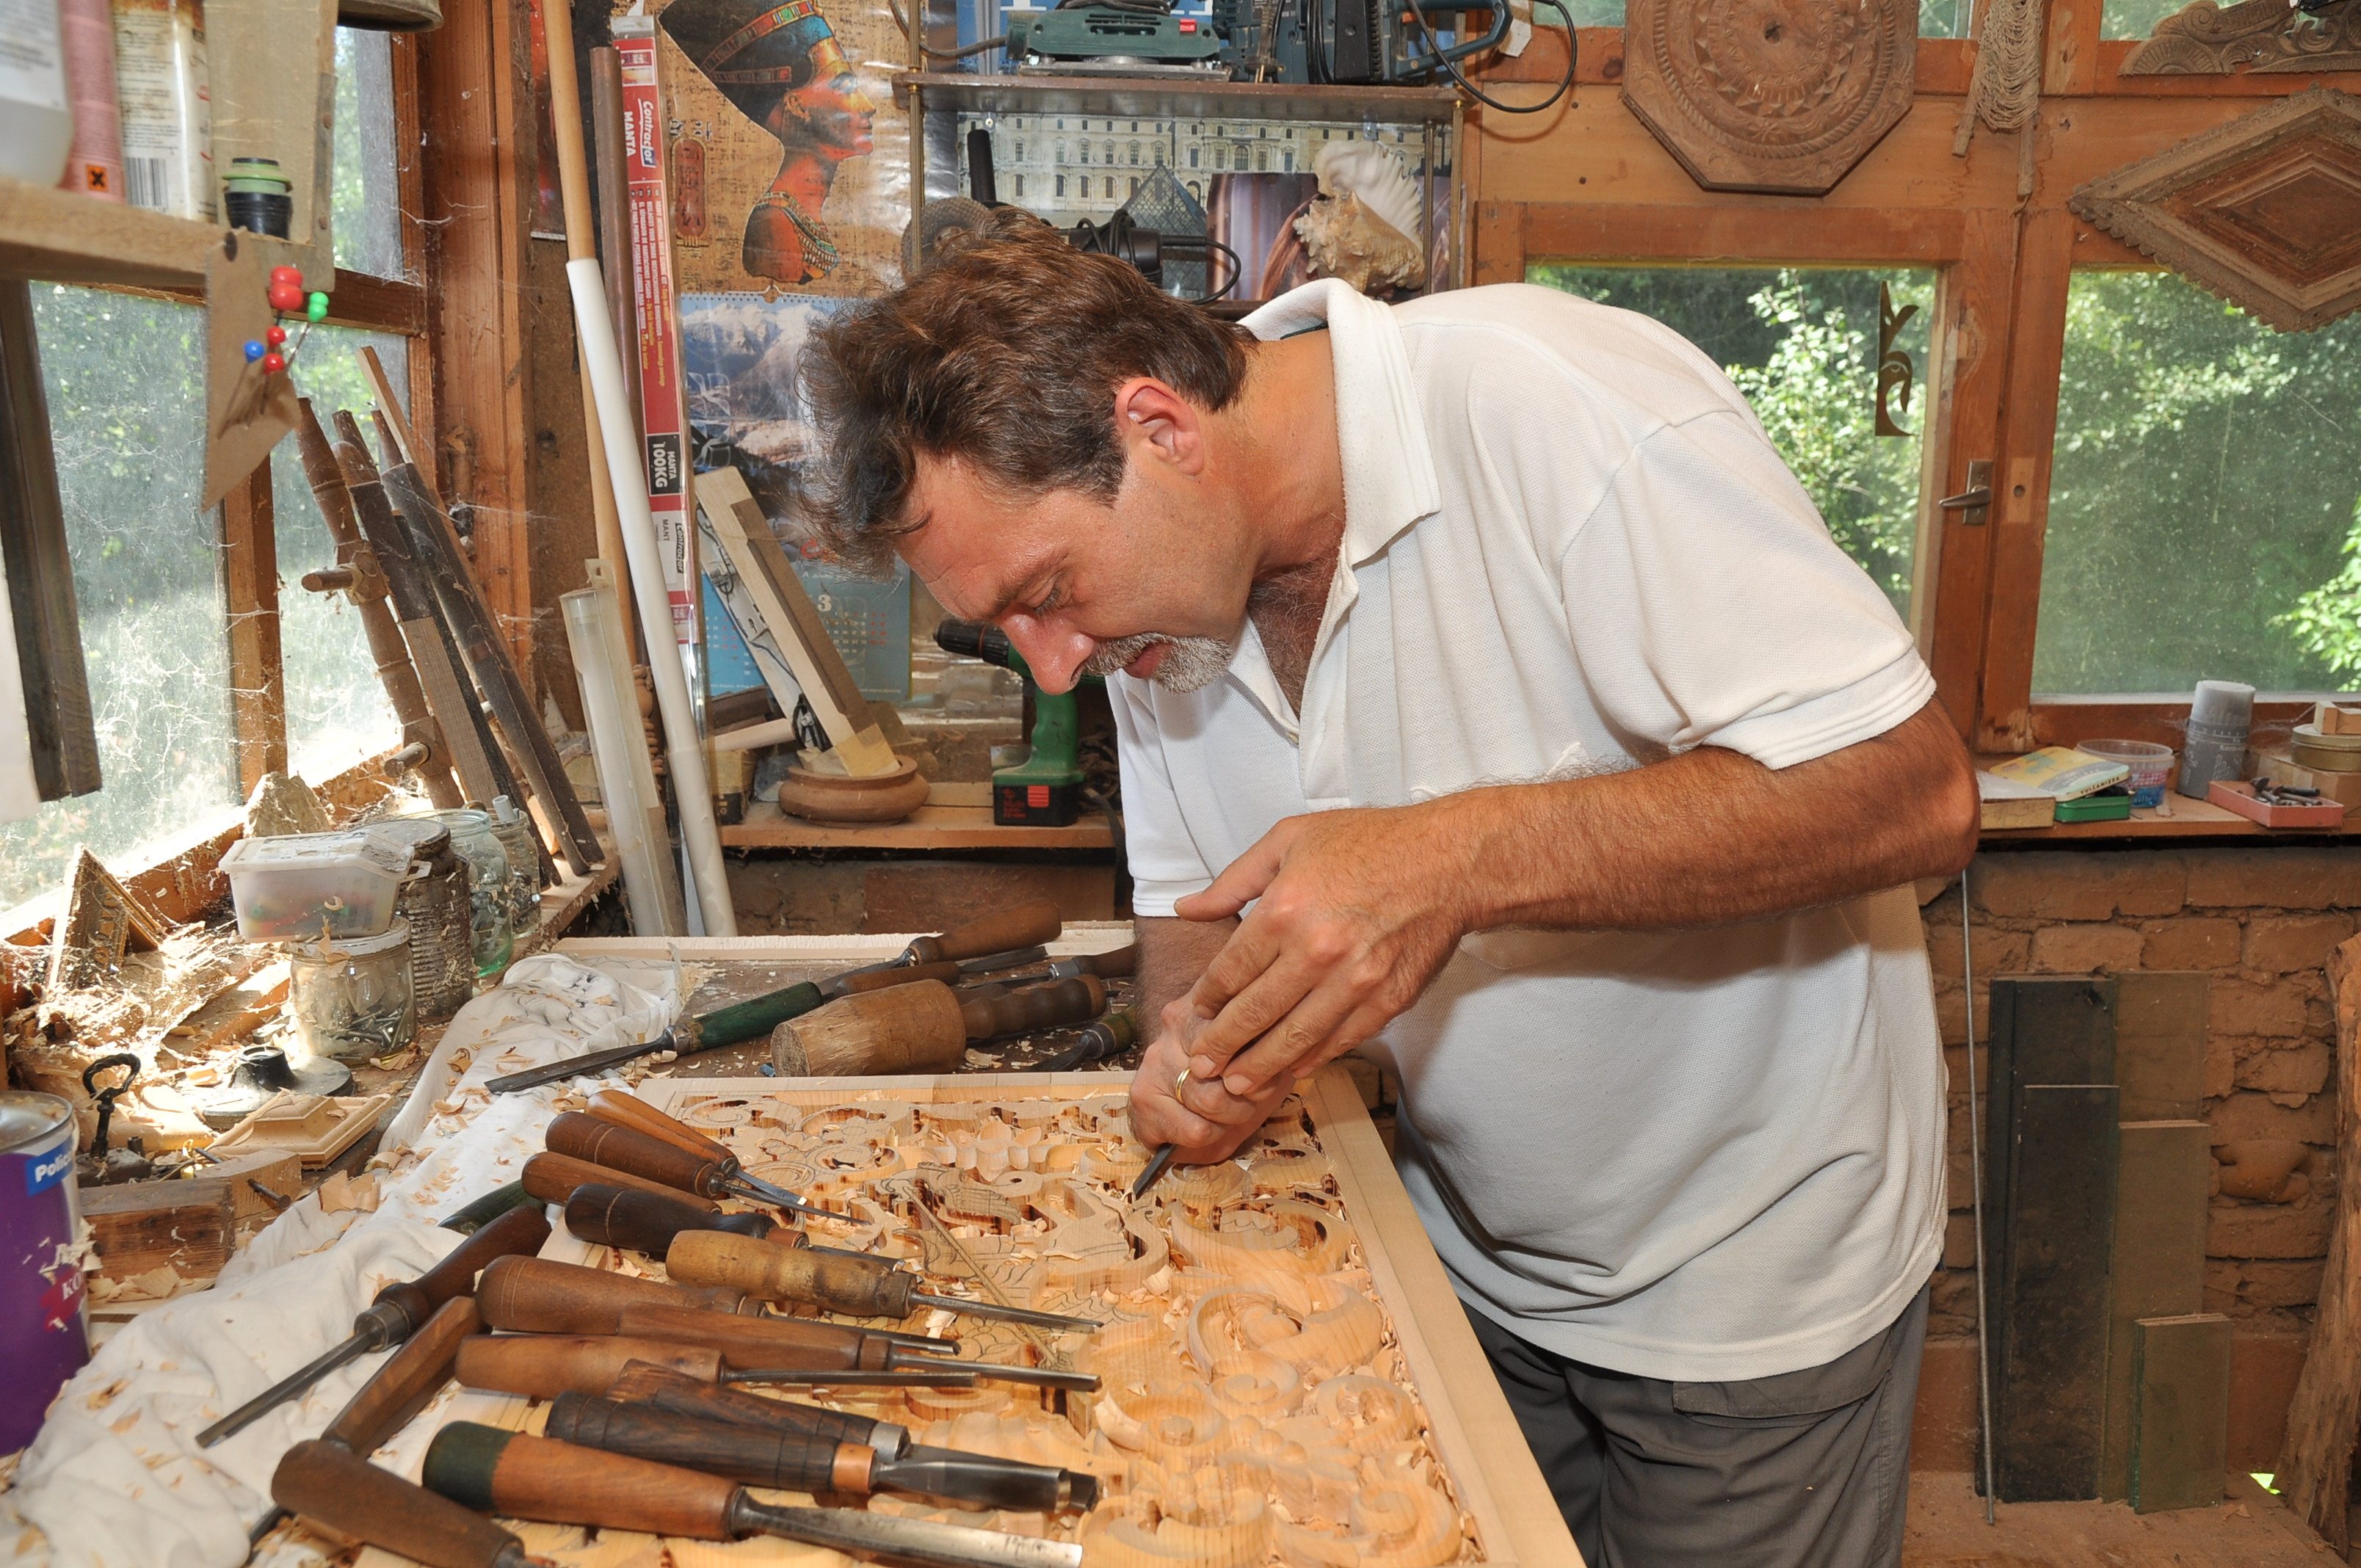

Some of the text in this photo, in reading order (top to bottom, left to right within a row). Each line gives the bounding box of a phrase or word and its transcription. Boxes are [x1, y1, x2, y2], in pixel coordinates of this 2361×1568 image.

[624, 111, 636, 157] MANTA
[642, 101, 655, 164] Contractor
[653, 442, 667, 487] 100KG
[667, 451, 677, 479] MANTA
[675, 524, 684, 572] Contractor
[817, 595, 832, 612] 3
[62, 1270, 83, 1301] KO
